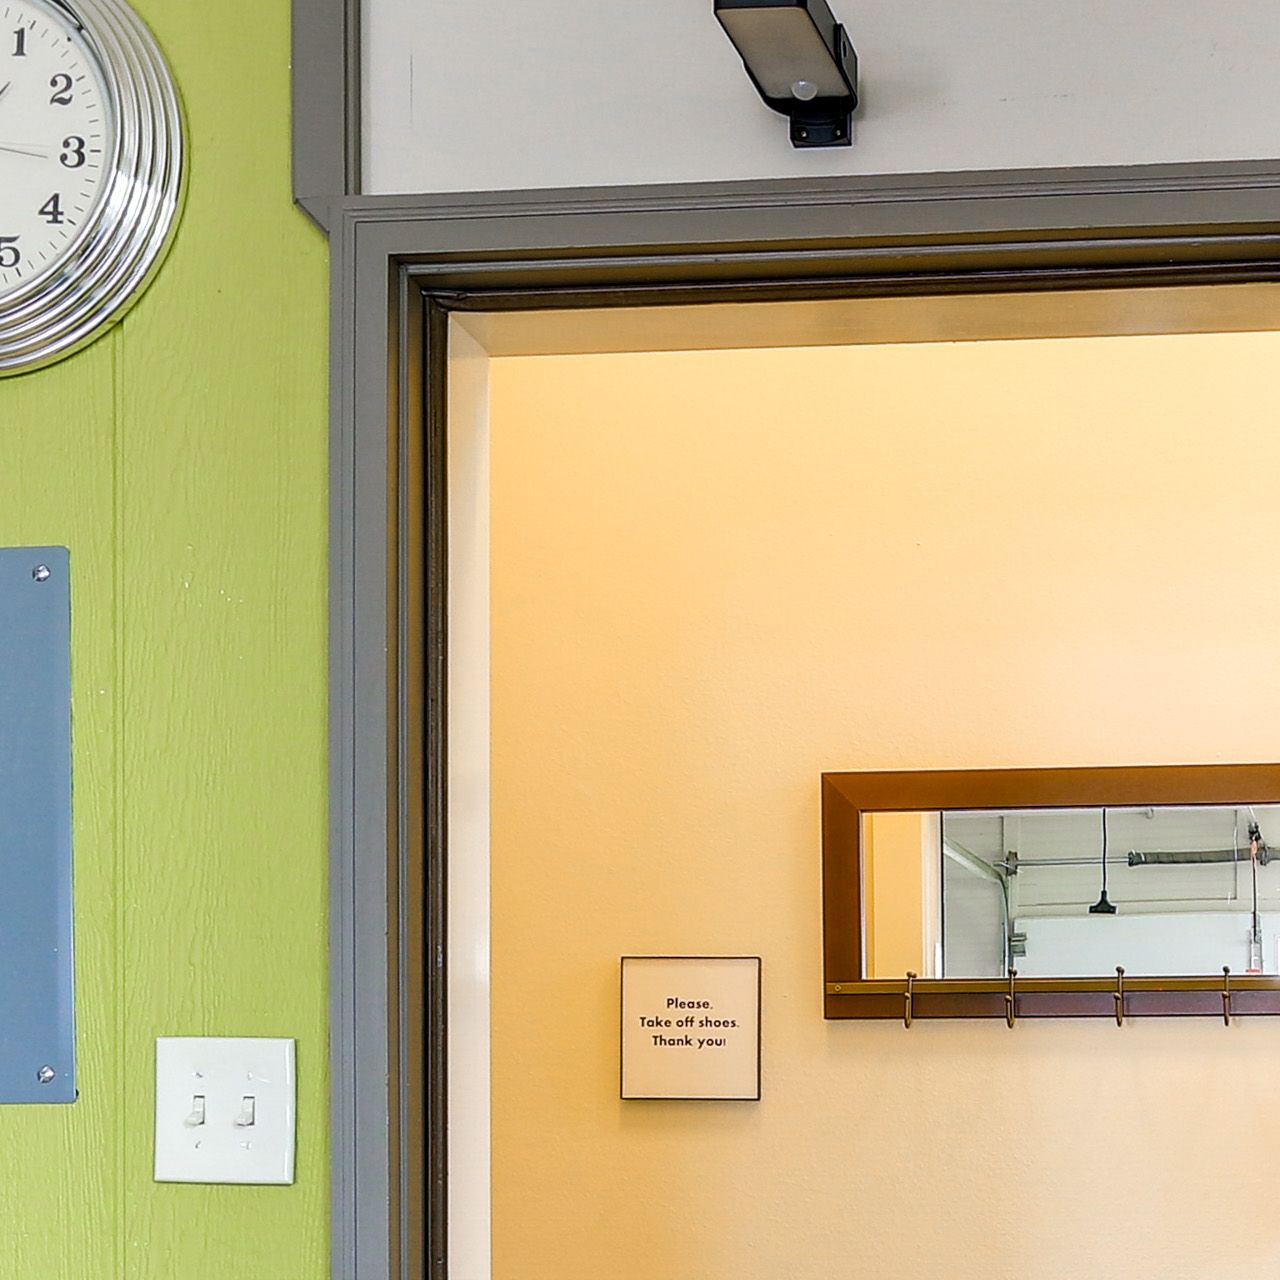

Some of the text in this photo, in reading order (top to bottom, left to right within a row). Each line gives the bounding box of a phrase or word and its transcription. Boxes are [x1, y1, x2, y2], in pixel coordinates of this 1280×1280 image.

[12, 27, 27, 57] 1
[49, 73, 74, 105] 2
[59, 136, 86, 168] 3
[38, 193, 65, 225] 4
[639, 1016, 740, 1028] Take off shoes.
[652, 1035, 693, 1047] Thank
